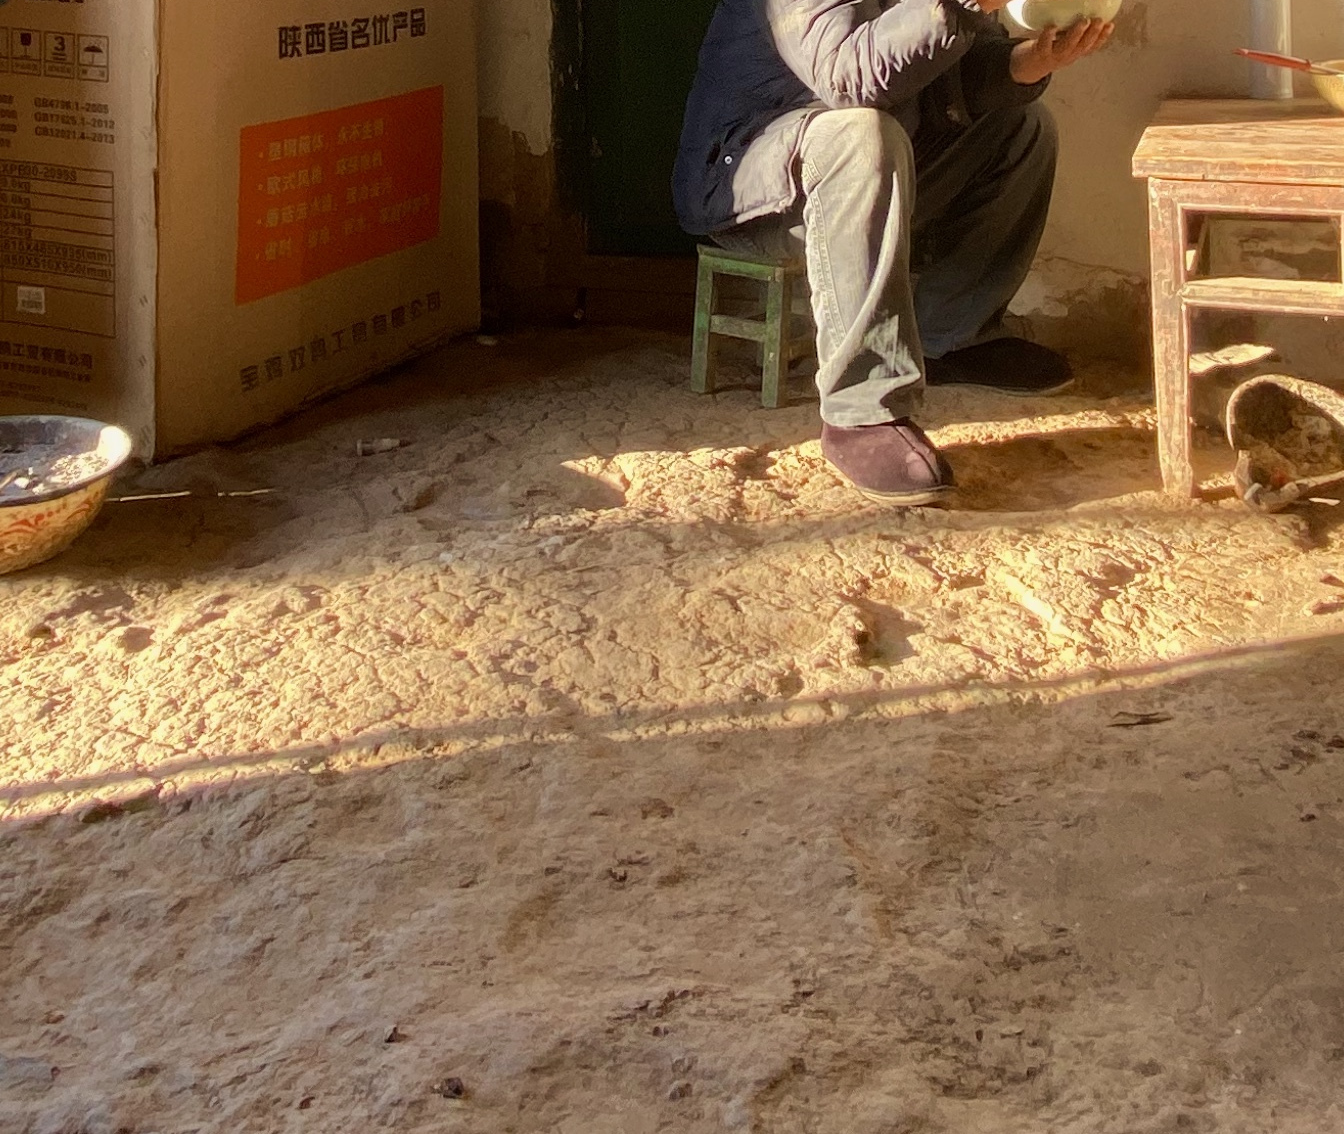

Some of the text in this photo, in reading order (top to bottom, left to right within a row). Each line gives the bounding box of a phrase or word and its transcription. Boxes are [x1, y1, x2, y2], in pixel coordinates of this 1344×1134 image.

[278, 8, 427, 60] 陕西省名优产品
